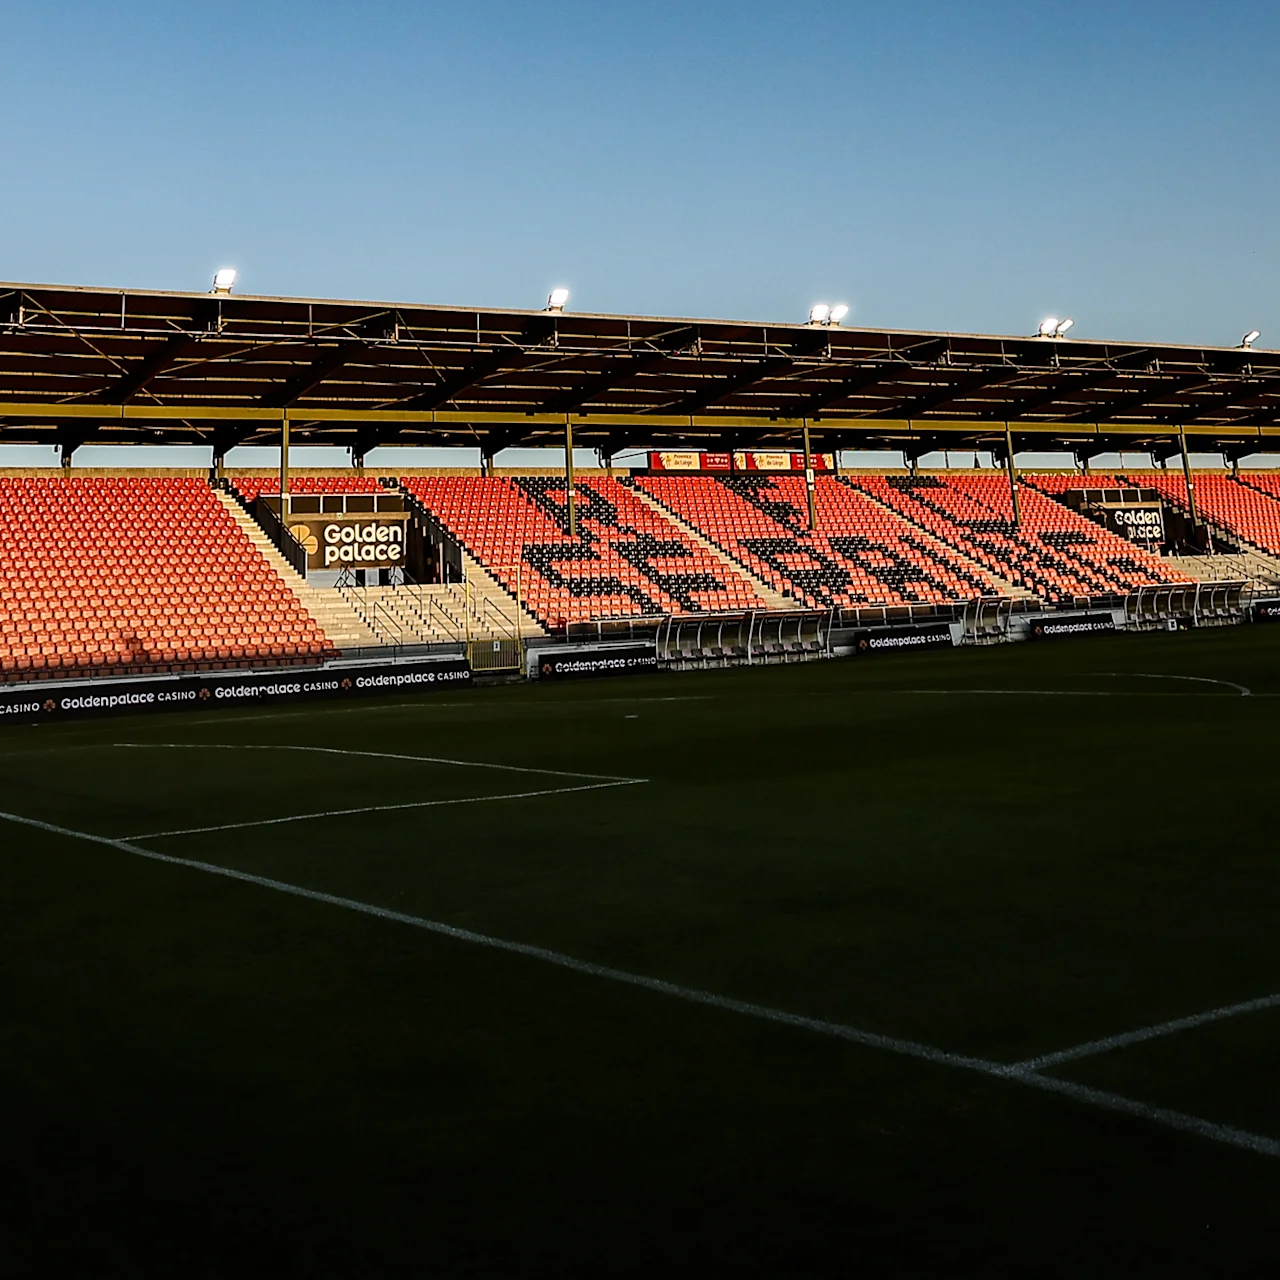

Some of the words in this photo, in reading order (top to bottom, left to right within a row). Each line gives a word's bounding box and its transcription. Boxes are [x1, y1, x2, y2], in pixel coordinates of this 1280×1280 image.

[324, 522, 402, 544] Golden
[324, 542, 402, 566] palace
[1044, 622, 1093, 634] Goldenpalace
[869, 634, 926, 648] Goldenpalace
[927, 633, 951, 643] CASINO
[555, 658, 626, 672] Goldenpalace
[303, 680, 339, 692] CASINO
[355, 671, 436, 688] Goldenpalace
[437, 670, 470, 681] CASINO
[61, 691, 155, 710] Goldenpalace
[157, 690, 197, 702] CASINO
